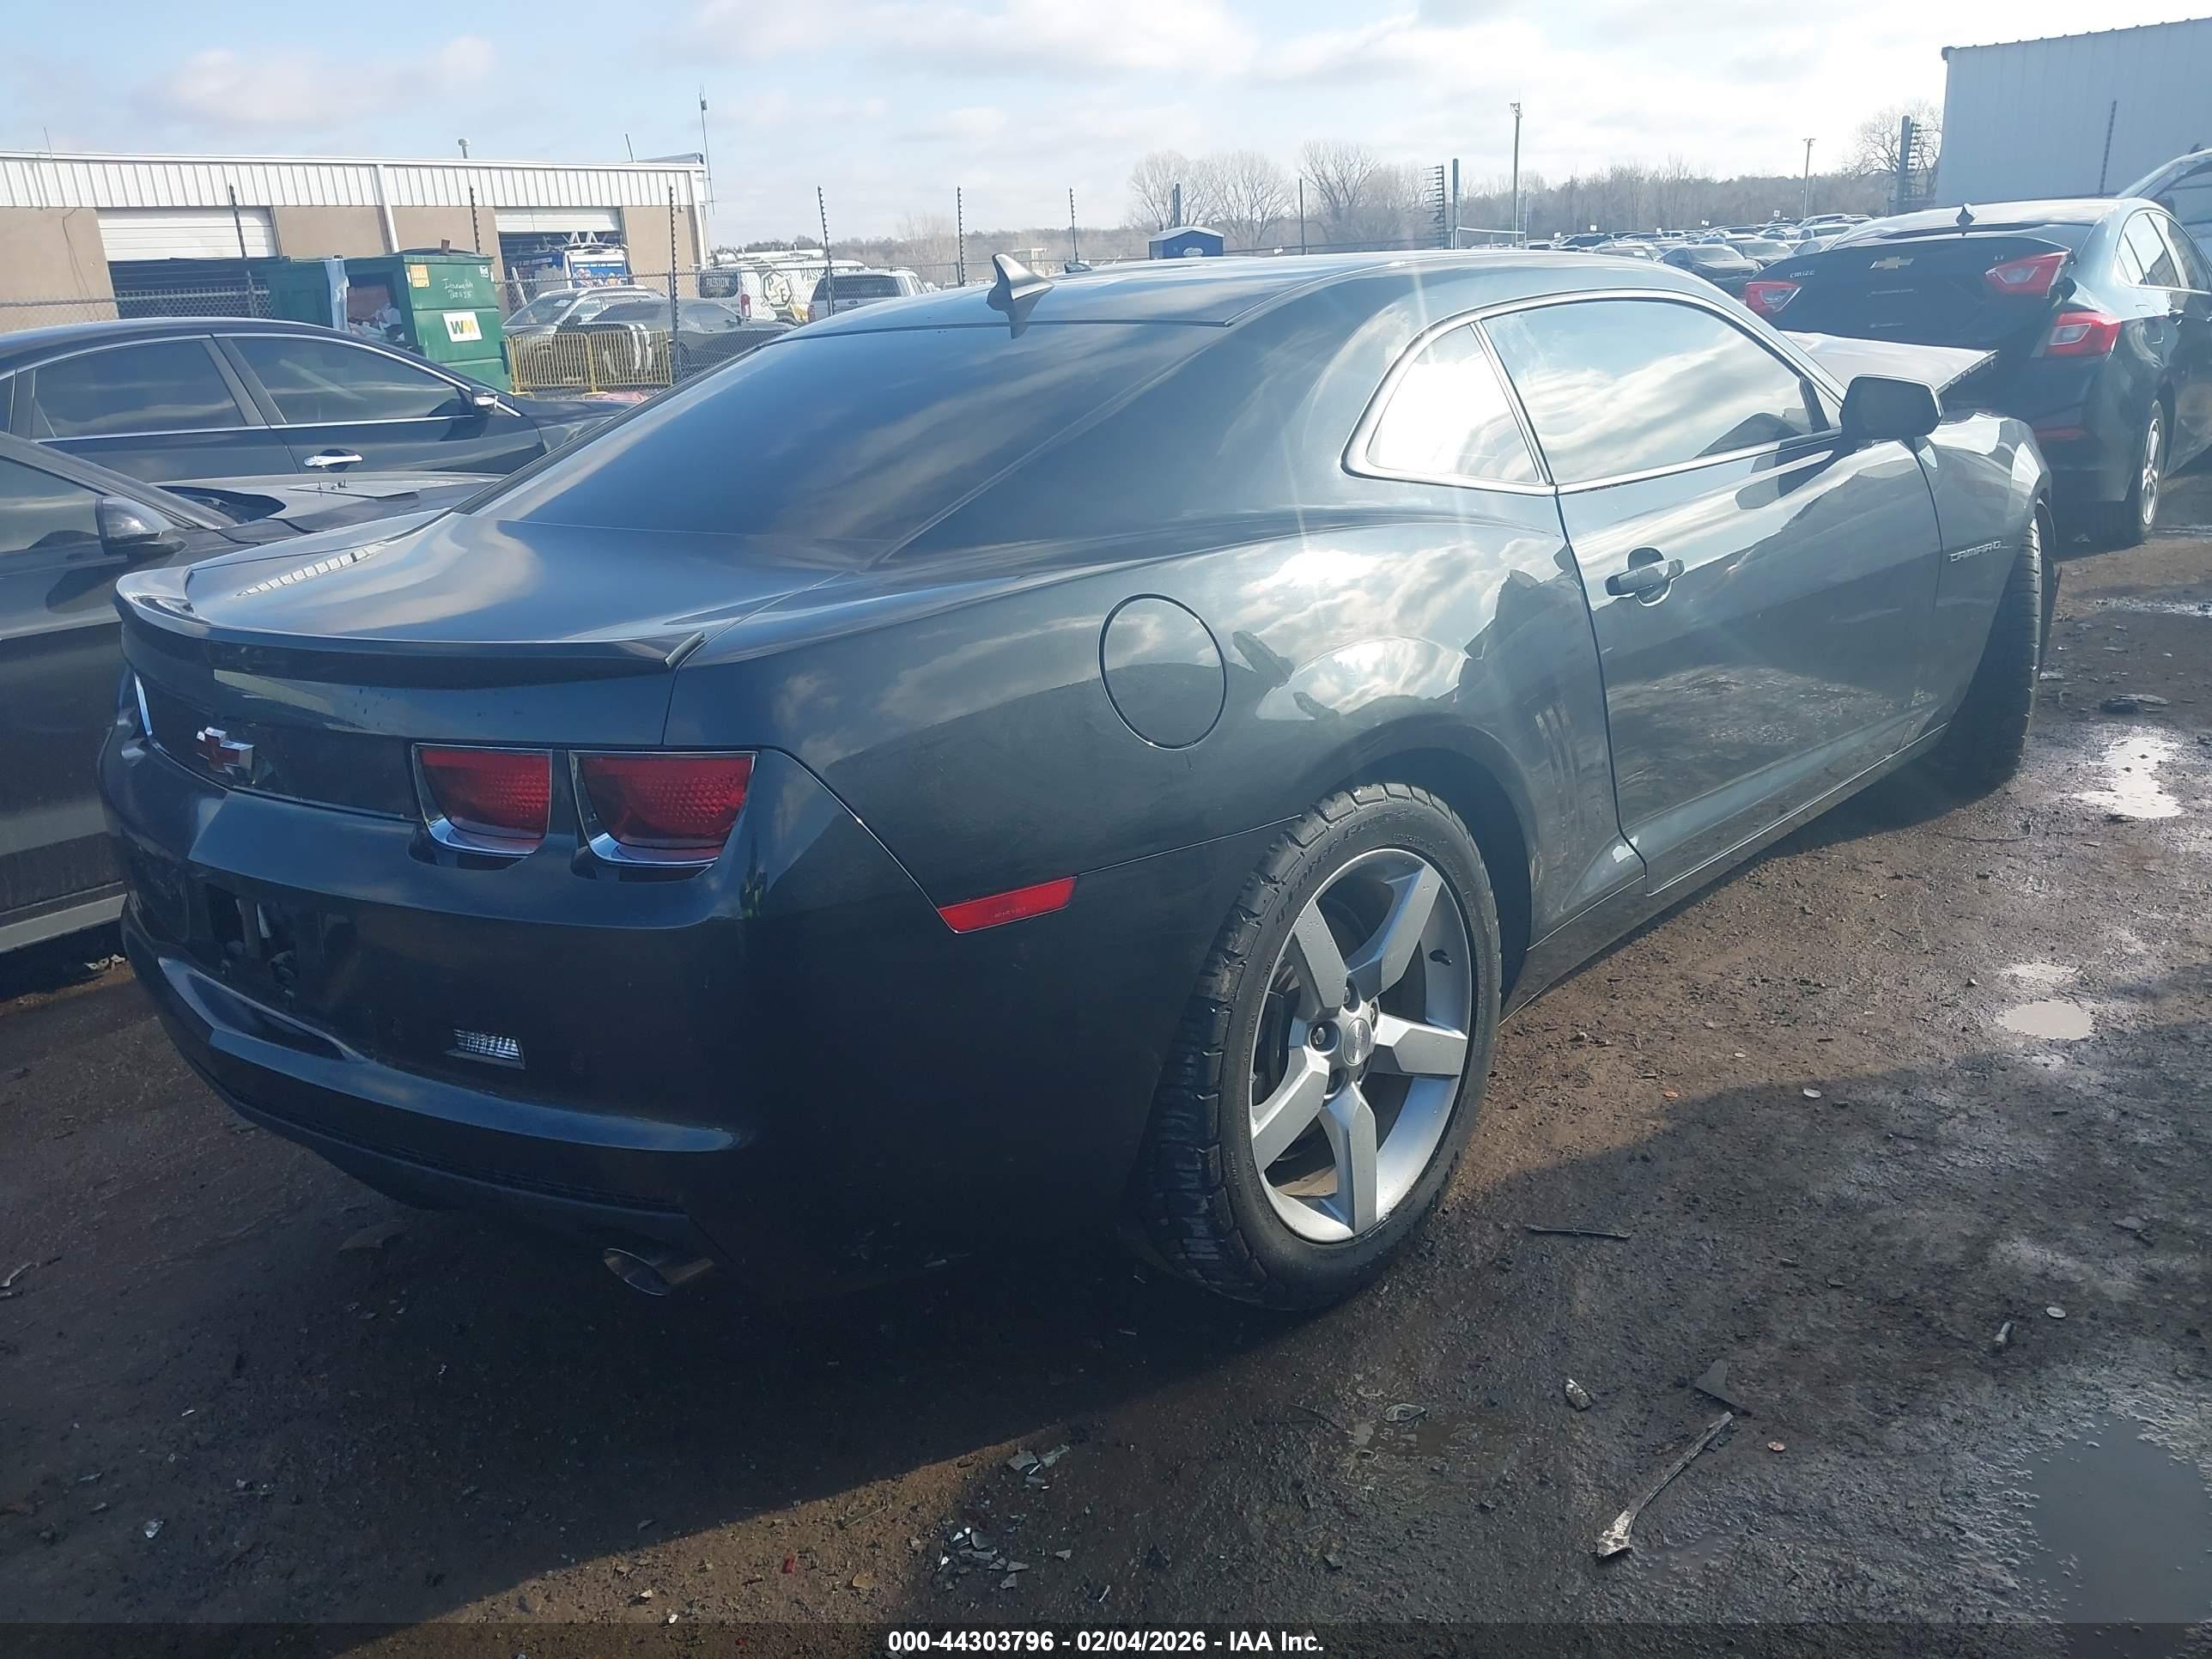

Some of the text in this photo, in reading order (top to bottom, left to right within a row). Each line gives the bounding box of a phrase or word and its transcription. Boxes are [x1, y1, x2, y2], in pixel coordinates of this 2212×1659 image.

[1790, 270, 1814, 278] CRUZE
[706, 276, 730, 289] PASSION
[450, 319, 477, 334] WM
[1948, 540, 2002, 562] CAMARO
